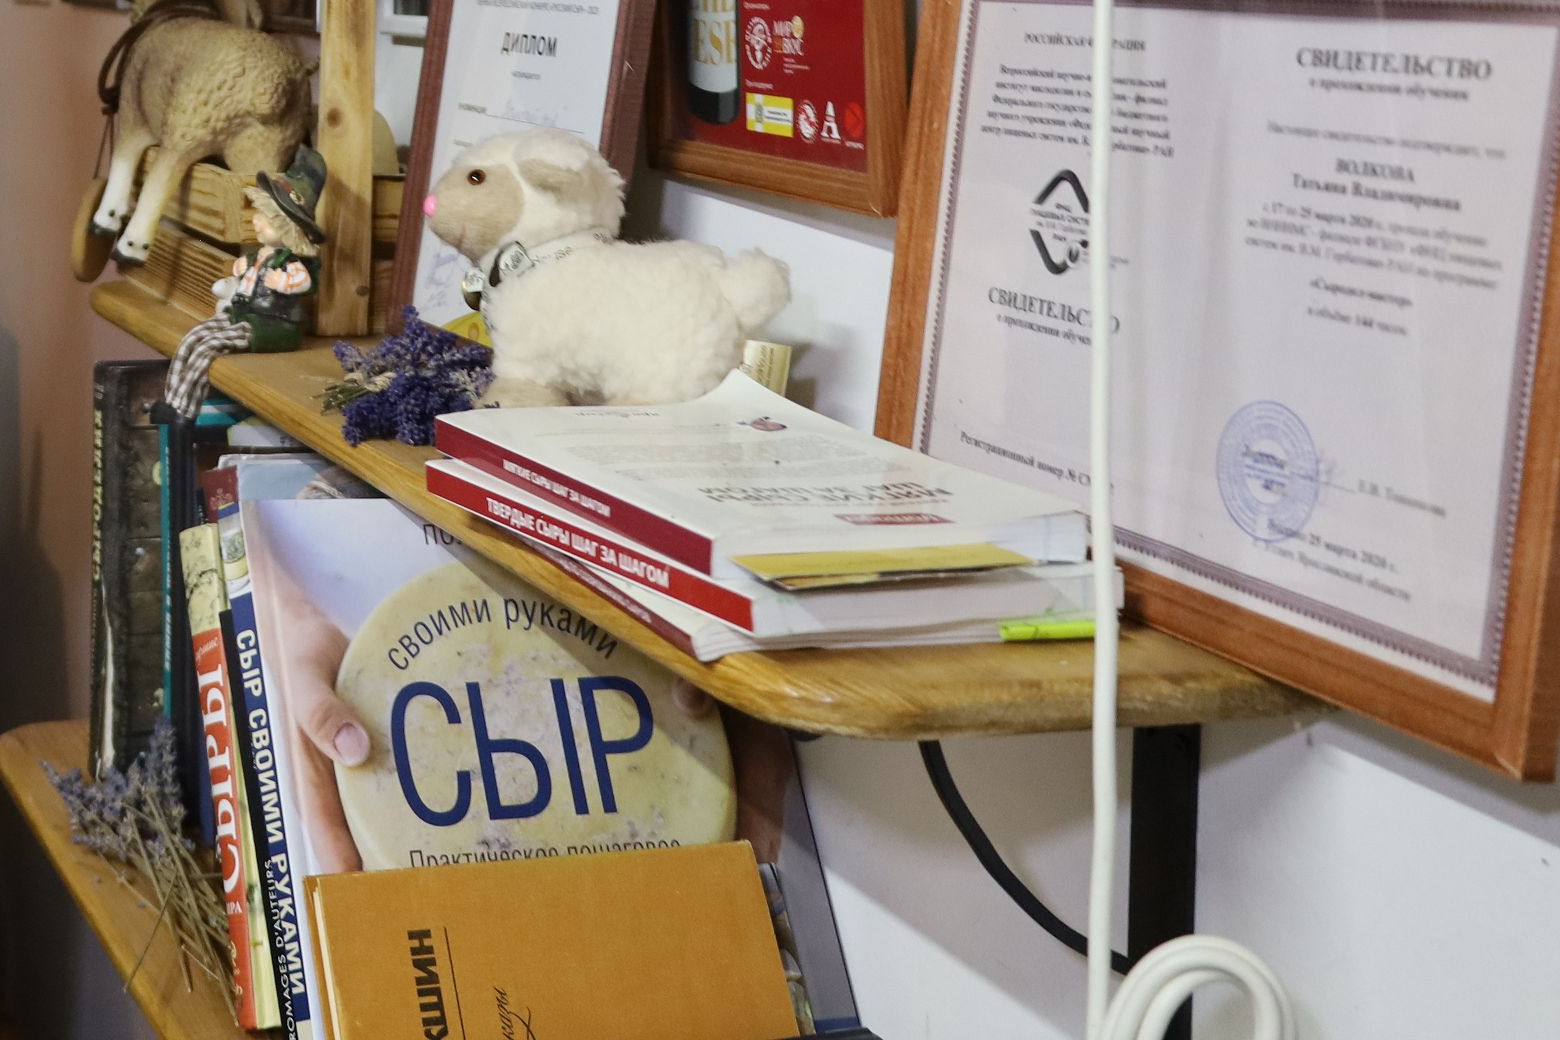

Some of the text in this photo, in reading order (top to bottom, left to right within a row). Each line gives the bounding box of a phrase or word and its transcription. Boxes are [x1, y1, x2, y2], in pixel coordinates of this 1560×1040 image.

[500, 31, 558, 57] ДИПЛОМ
[1295, 46, 1492, 82] СВИДЕТЕЛЬСТВО
[485, 496, 670, 590] ТВЕРДЫЕ СЫРЫ ШАГ ЗА ШАГОМ
[387, 595, 620, 671] своими руками
[236, 628, 306, 956] СЫР СВОИМИ РУКАМИ
[390, 674, 655, 828] СЫР
